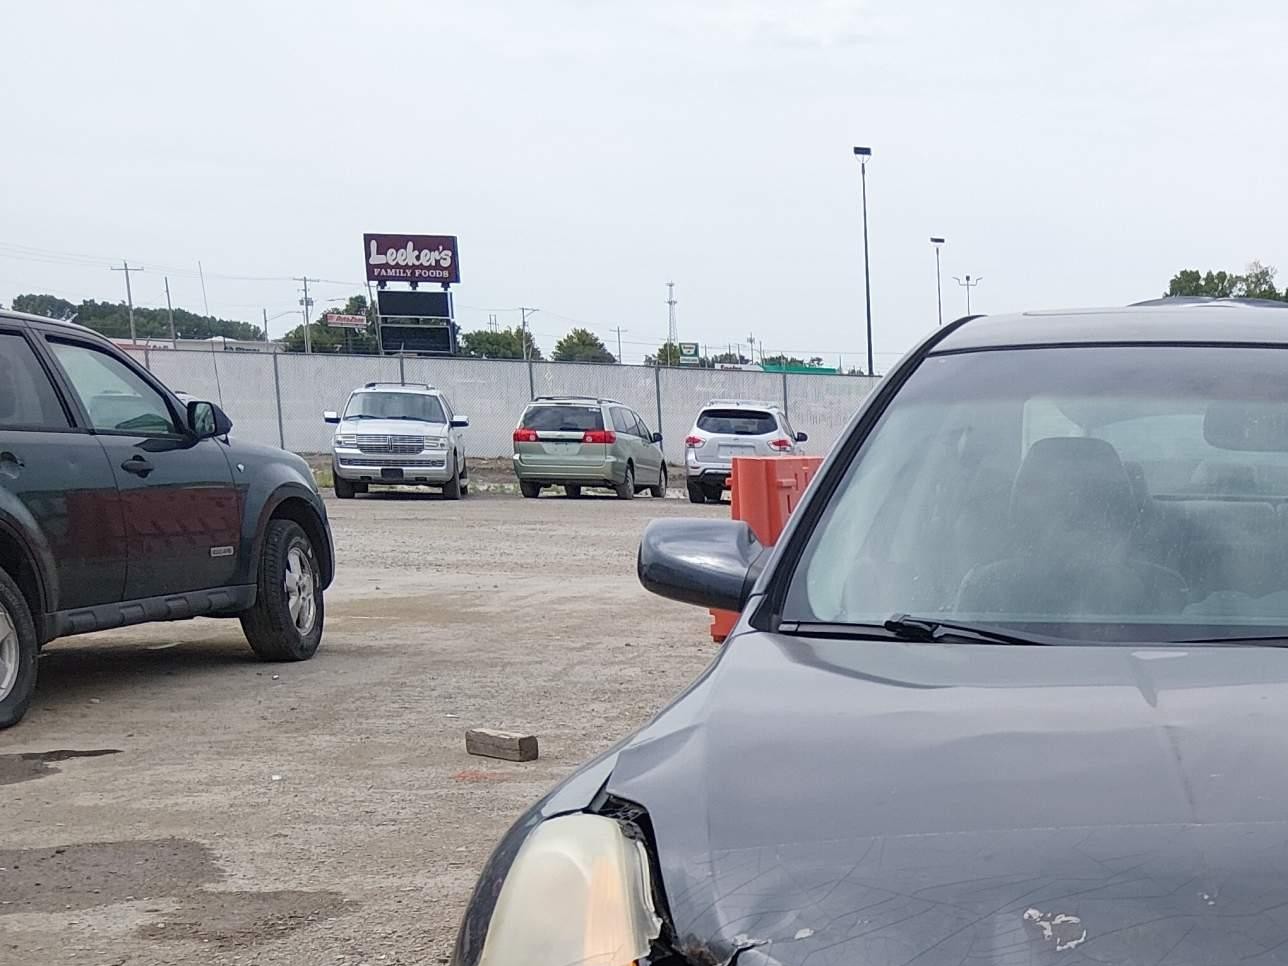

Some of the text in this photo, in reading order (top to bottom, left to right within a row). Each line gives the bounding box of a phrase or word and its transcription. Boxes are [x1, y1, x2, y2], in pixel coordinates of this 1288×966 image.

[369, 239, 452, 267] Leeker's
[373, 268, 449, 278] FAMILY FOODS
